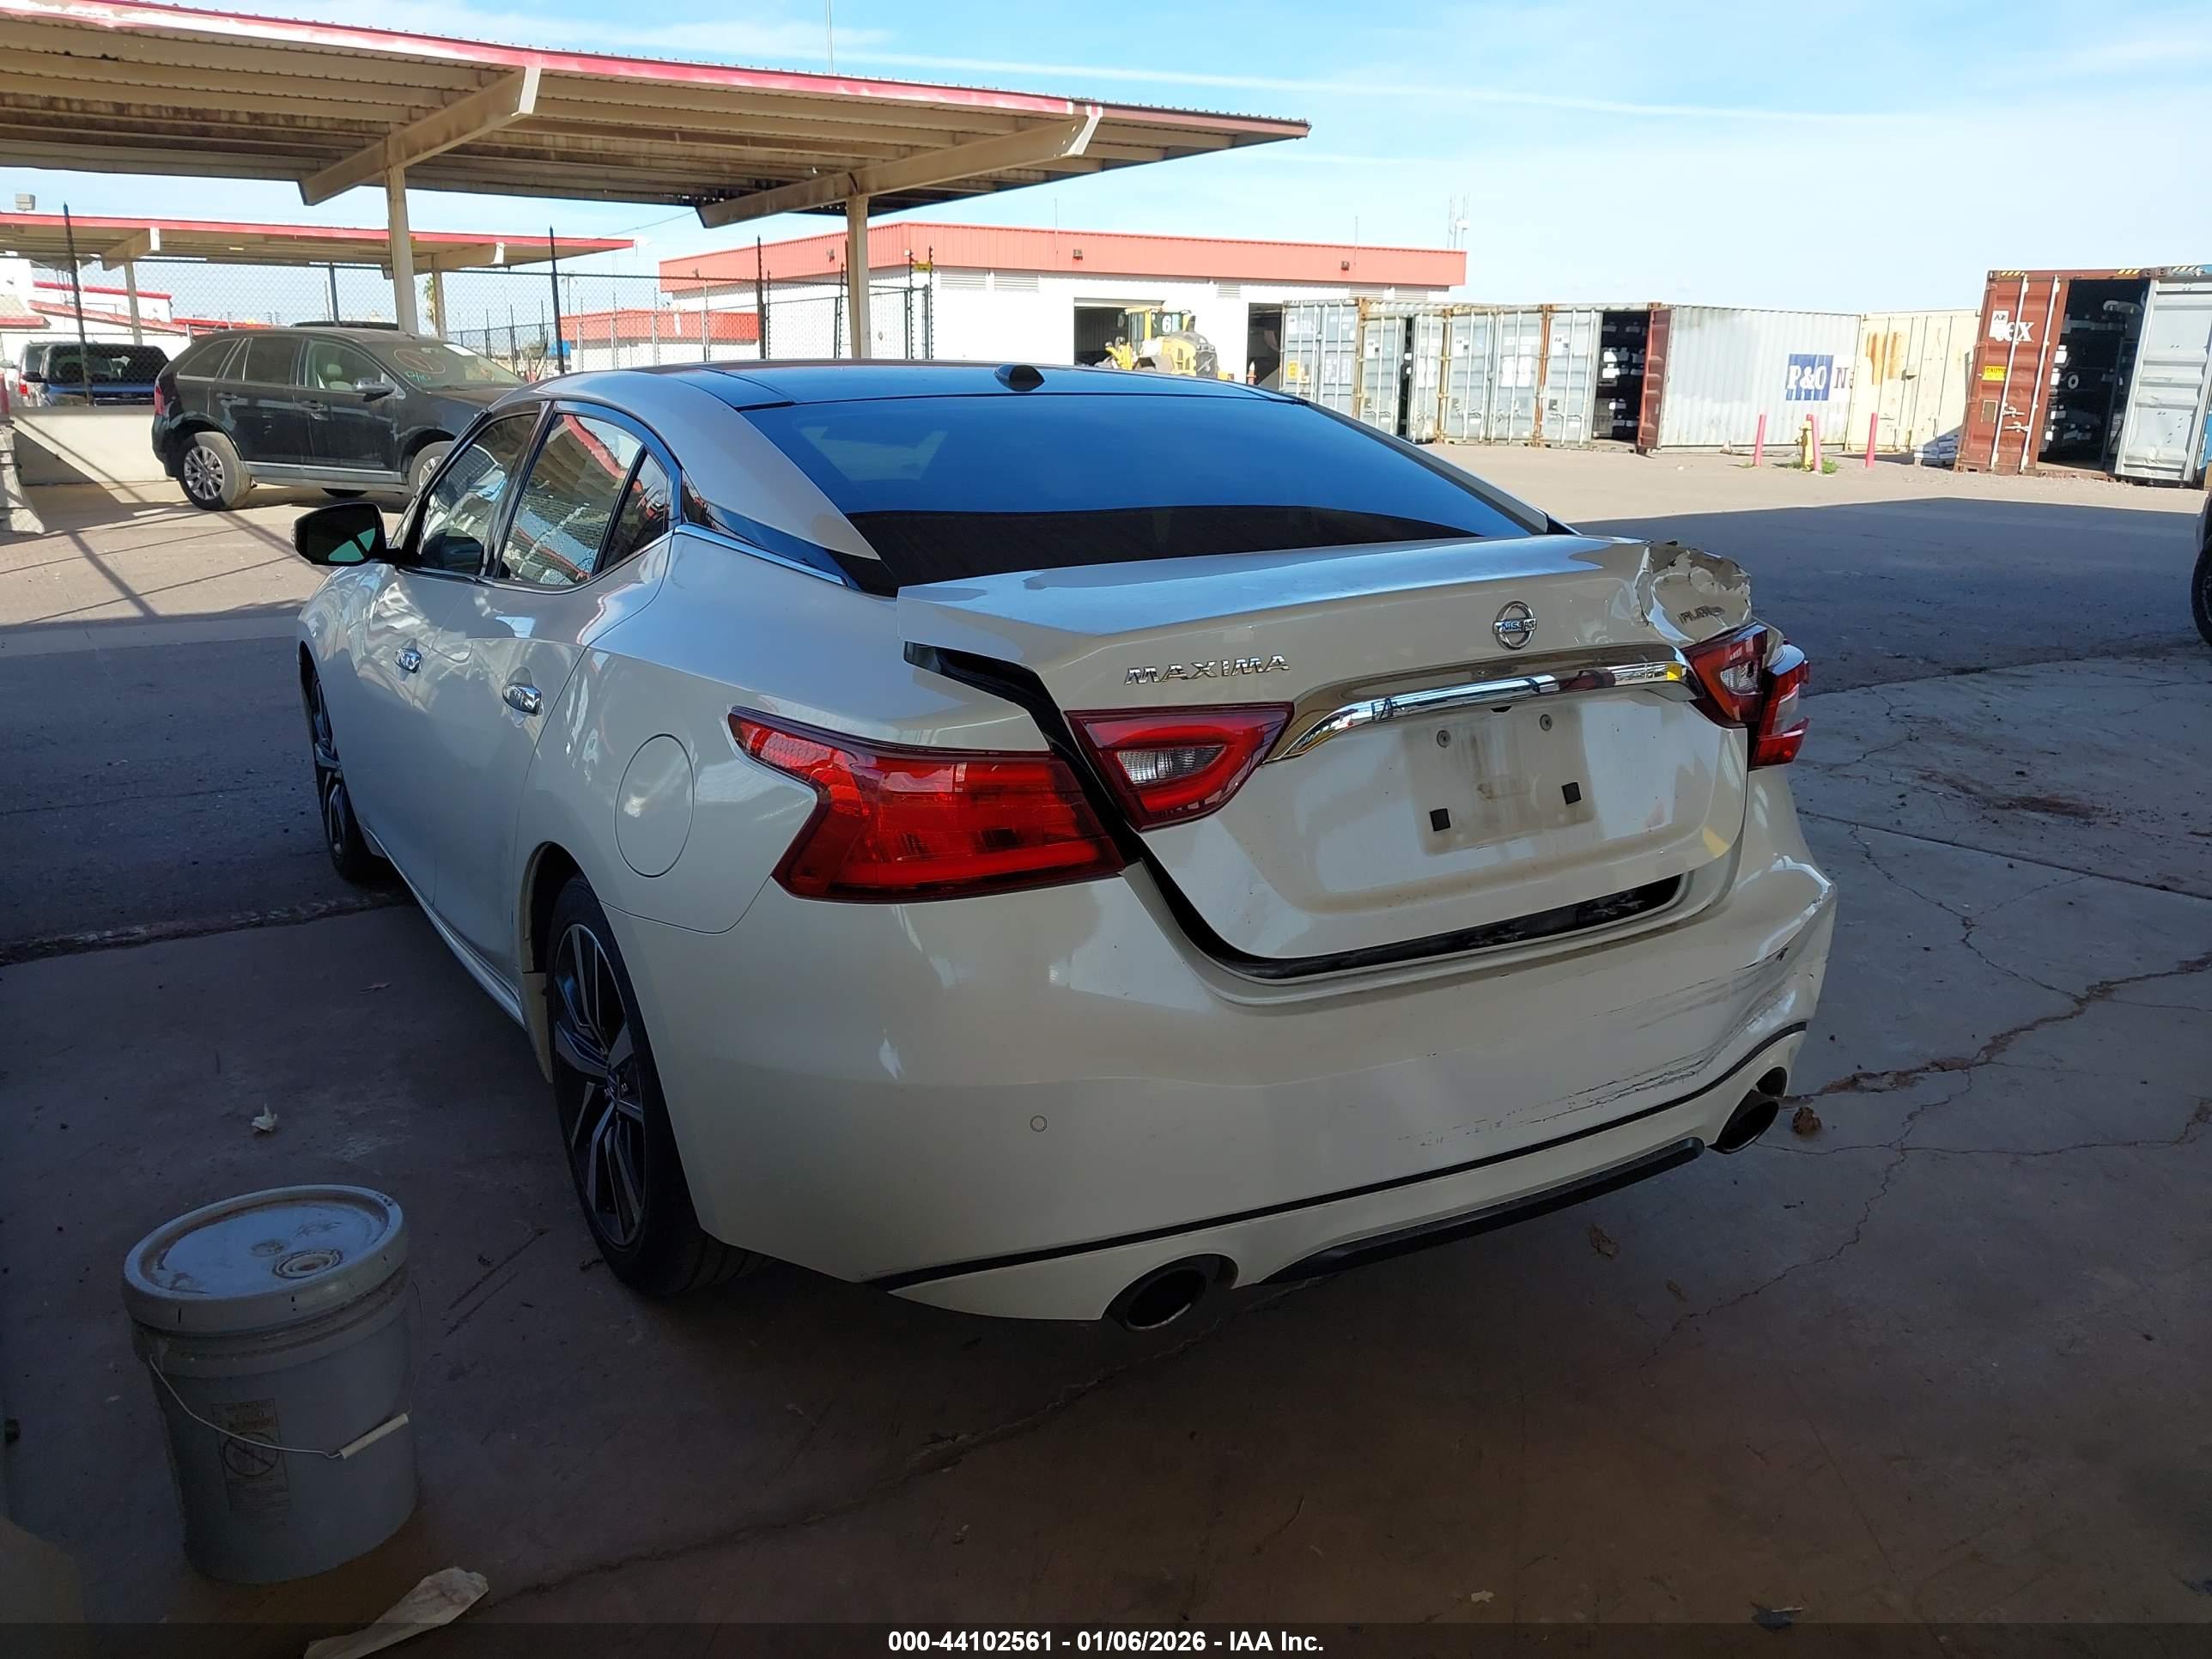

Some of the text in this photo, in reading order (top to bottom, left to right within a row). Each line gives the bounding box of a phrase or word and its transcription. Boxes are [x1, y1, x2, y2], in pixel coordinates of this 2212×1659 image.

[1162, 315, 1172, 333] 6
[1787, 365, 1826, 390] P&O
[1124, 653, 1291, 686] MAXIMA
